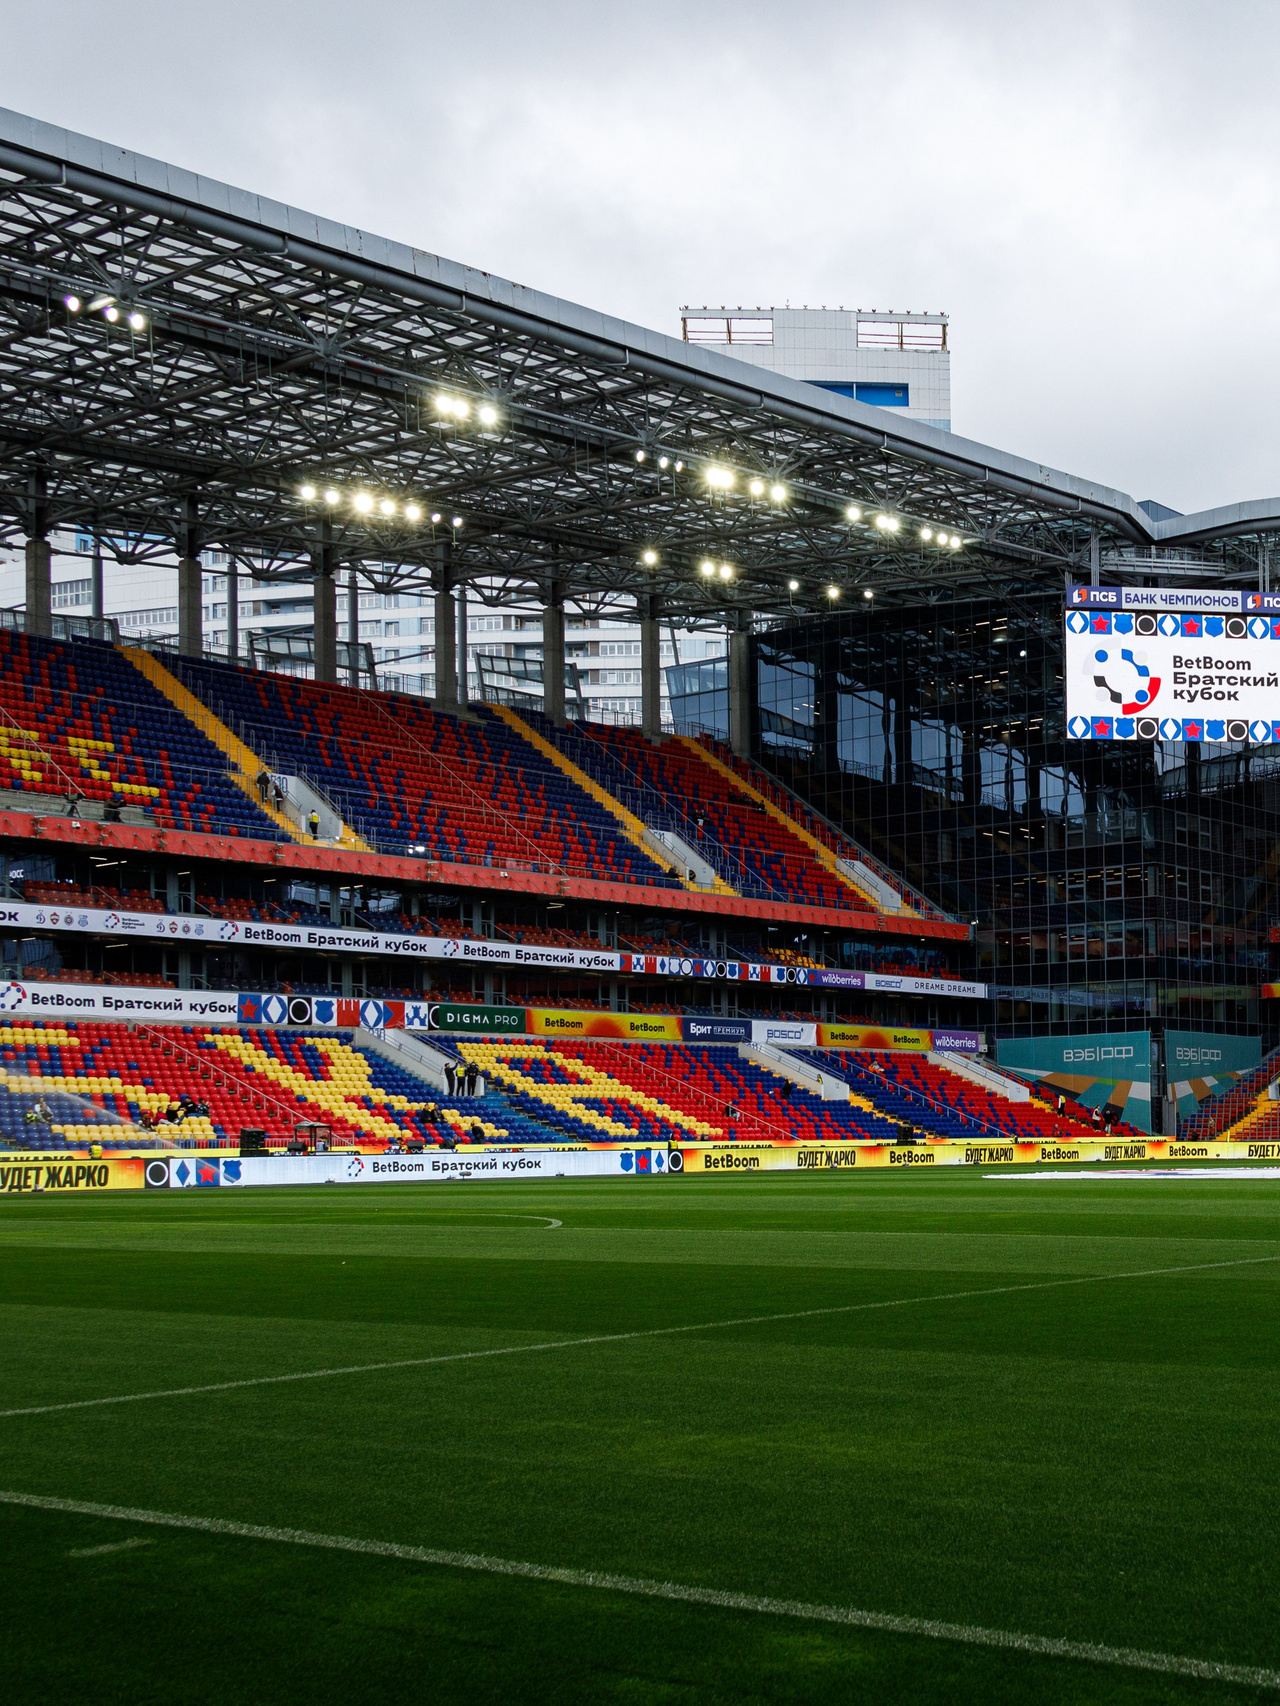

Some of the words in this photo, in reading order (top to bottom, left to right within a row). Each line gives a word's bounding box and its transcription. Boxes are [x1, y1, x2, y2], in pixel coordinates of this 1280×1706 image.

[1090, 591, 1117, 603] ПСБ
[1124, 593, 1157, 605] БАНК
[1160, 594, 1239, 607] ЧЕМПИОНОВ
[1172, 655, 1251, 671] BetBoom
[1172, 672, 1279, 688] Братский
[1172, 687, 1240, 702] кубок
[244, 928, 301, 943] BetBoom
[307, 932, 379, 949] Братский
[384, 940, 428, 953] кубок
[463, 945, 510, 959] BetBoom
[515, 950, 574, 964] Братский
[579, 955, 615, 967] кубок
[821, 974, 861, 986] wildberries
[875, 979, 903, 989] BOSCO
[914, 982, 945, 991] DREAME
[947, 984, 976, 993] DREAME
[30, 993, 96, 1007] BetBoom
[102, 997, 183, 1012] Братский
[189, 1002, 238, 1014] кубок
[446, 1013, 490, 1025] DIGMA
[494, 1014, 519, 1026] PRO
[545, 1017, 583, 1029] BetBoom
[630, 1022, 665, 1033] BetBoom
[689, 1022, 712, 1035] Брит
[713, 1026, 745, 1035] ПРЕМИУМ
[767, 1028, 804, 1039] BOSCO
[830, 1031, 859, 1041] BetBoom
[893, 1035, 921, 1045] BetBoom
[935, 1034, 976, 1048] wildberries
[889, 1150, 935, 1164] BetBoom
[965, 1148, 988, 1163] БУДЕТ
[988, 1147, 1014, 1162] ЖАРКО
[1041, 1148, 1079, 1160] BetBoom
[1104, 1146, 1124, 1160] БУДЕТ
[1124, 1145, 1146, 1159] ЖАРКО
[1169, 1145, 1208, 1157] BetBoom
[1248, 1144, 1277, 1158] БУДЕТ
[372, 1161, 424, 1173] BetBoom
[432, 1158, 497, 1172] Братский
[502, 1157, 542, 1171] кубок
[704, 1153, 760, 1169] BetBoom
[797, 1151, 825, 1168] БУДЕТ
[825, 1150, 856, 1167] ЖАРКО
[0, 1166, 43, 1191] УДЕТ
[44, 1164, 110, 1188] ЖАРКО
